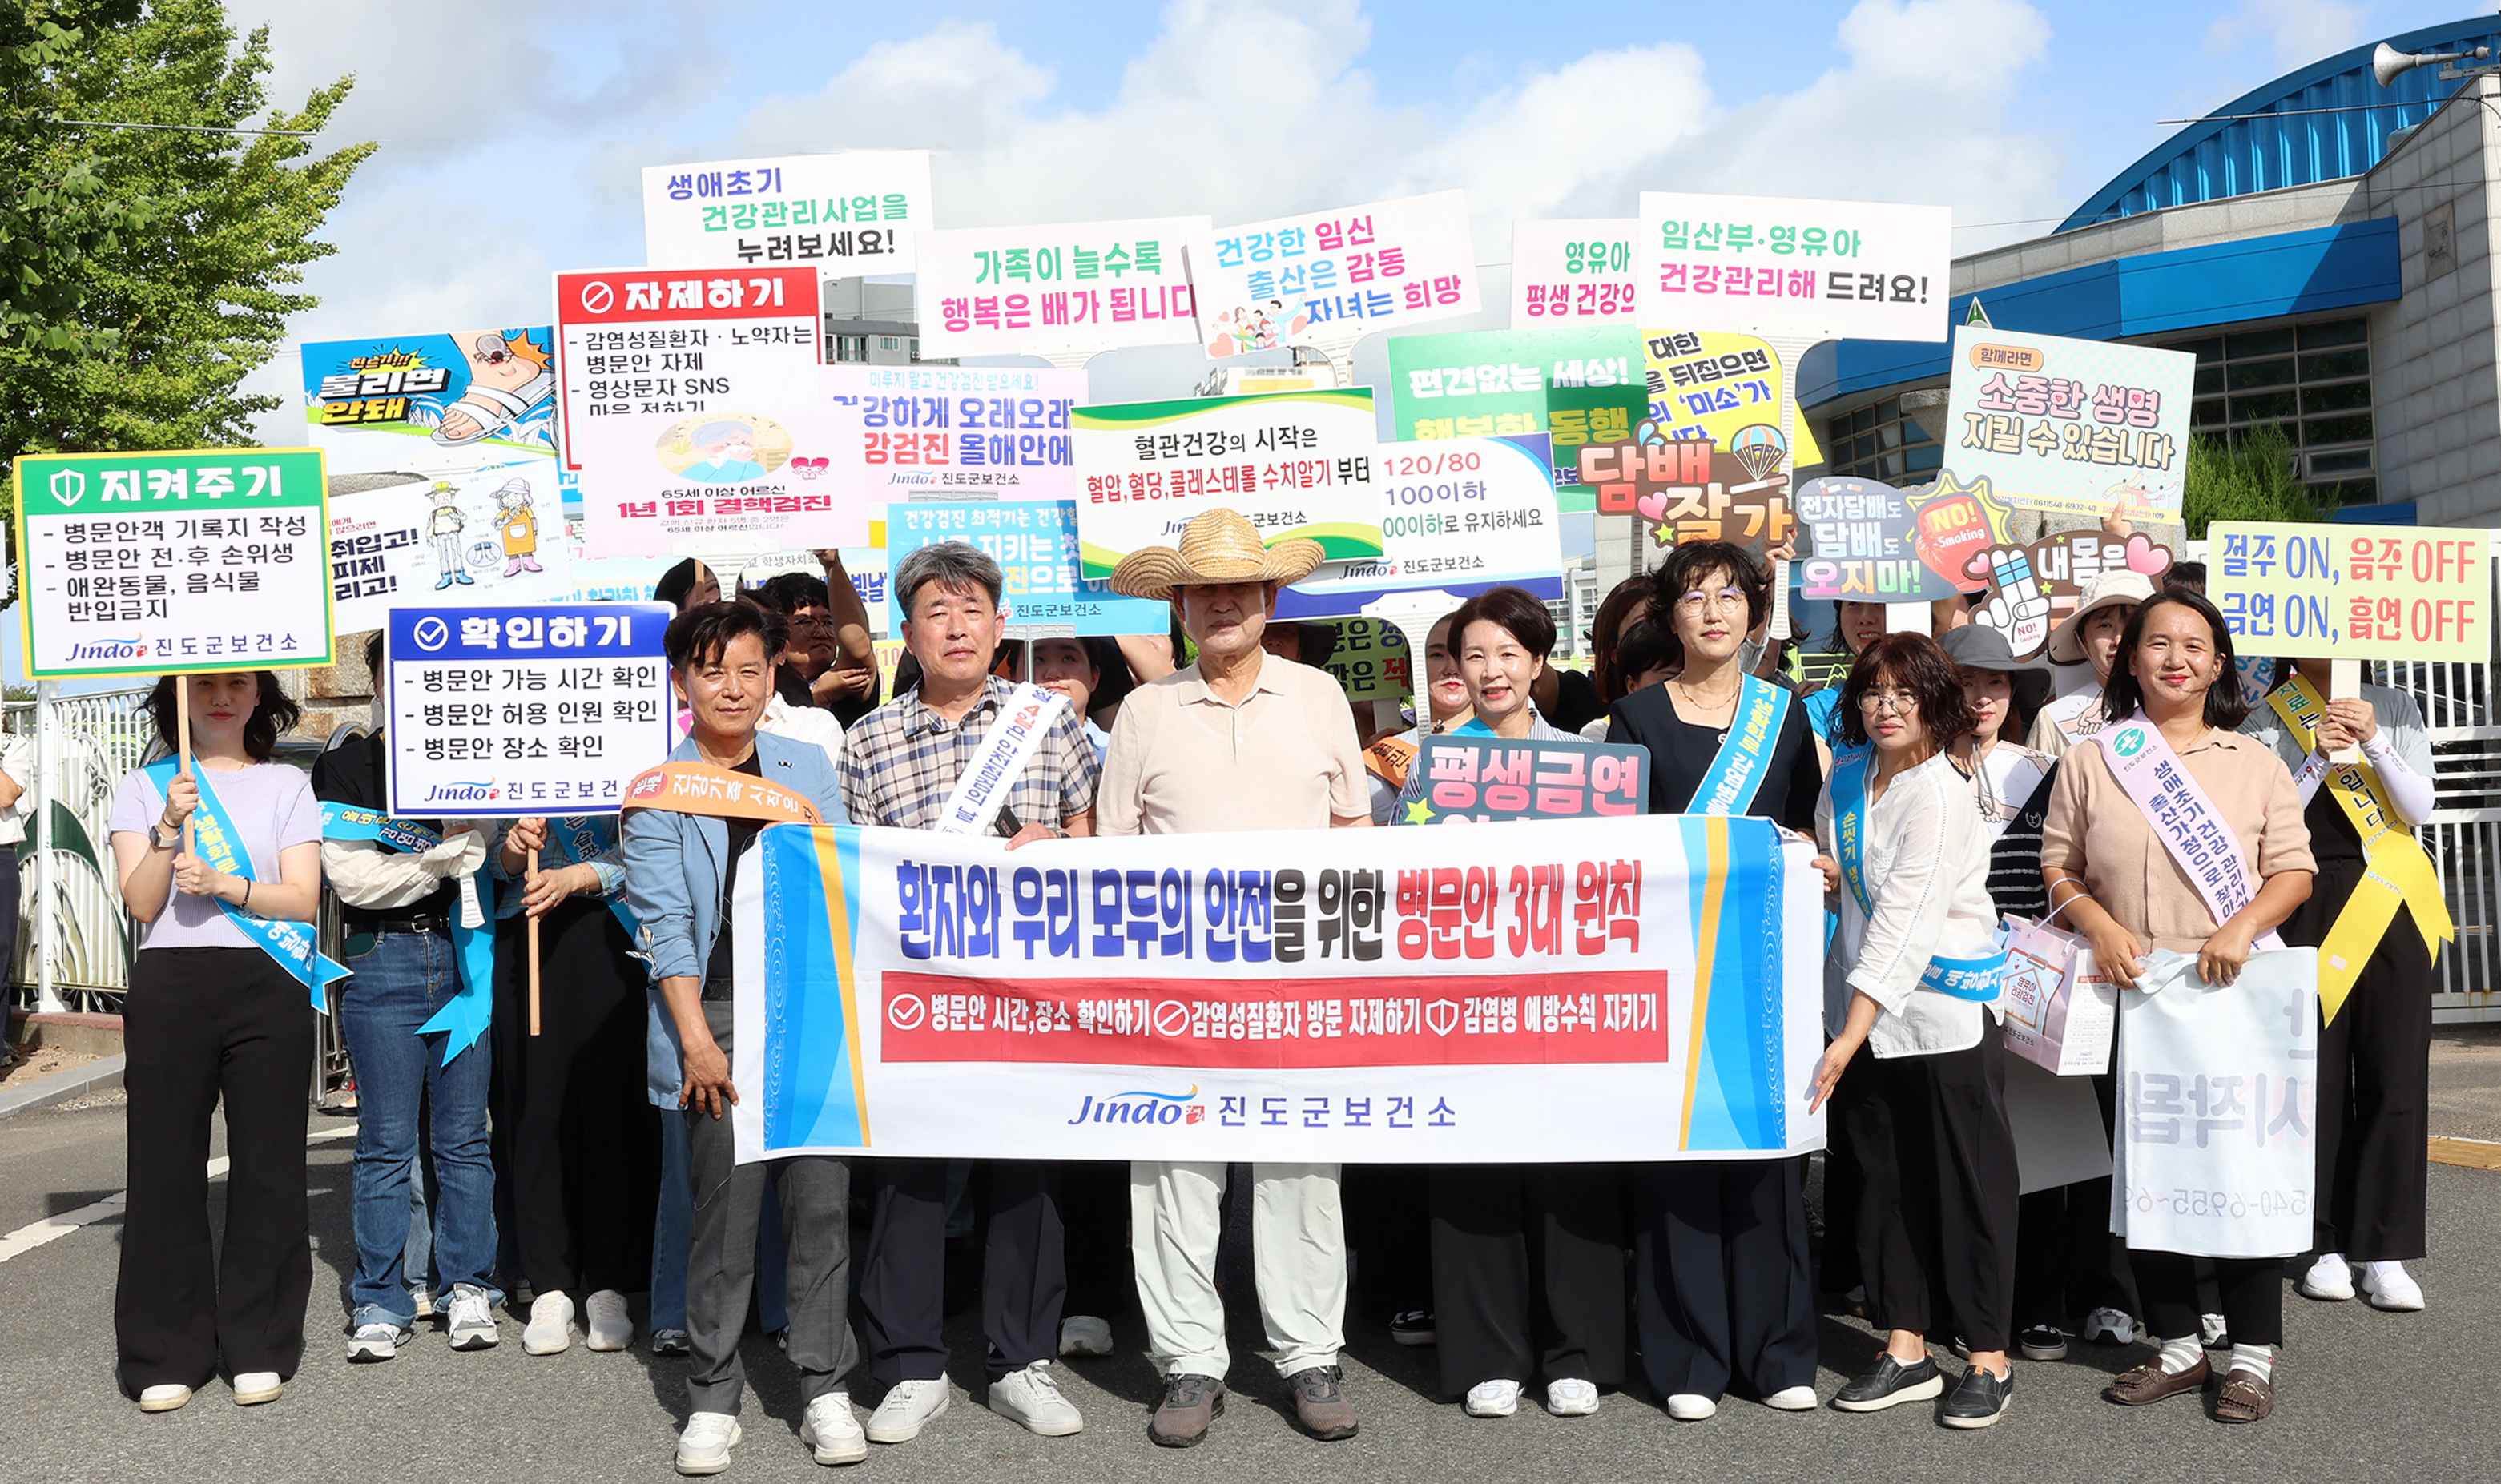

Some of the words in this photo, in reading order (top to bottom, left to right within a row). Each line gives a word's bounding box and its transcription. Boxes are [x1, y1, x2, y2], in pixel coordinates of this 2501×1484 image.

[667, 168, 782, 200] 생애초기
[703, 194, 908, 232] 건강관리사업을
[738, 229, 895, 263] 누려보세요!
[1215, 227, 1306, 268] 건강한
[1315, 215, 1375, 251] 임신
[1661, 220, 1861, 258] 임산부·영유아
[974, 246, 1062, 284] 가족이
[1073, 241, 1162, 280] 늘수록
[1247, 259, 1337, 301] 출산은
[1346, 247, 1405, 284] 감동
[1565, 241, 1631, 275] 영유아
[625, 278, 784, 311] 자제하기
[1304, 289, 1394, 324] 자녀는
[1403, 275, 1462, 310] 희망
[1660, 263, 1816, 300] 건강관리해
[1826, 271, 1928, 304] 드려요!
[941, 293, 1031, 332] 행복은
[1041, 290, 1100, 326] 배가
[1526, 284, 1569, 316] 평생
[586, 328, 708, 351] 감염성질환자
[732, 326, 812, 346] 노약자는
[1648, 332, 1702, 359] 대한
[587, 354, 652, 375] 병문안
[661, 352, 703, 371] 자제
[1669, 349, 1770, 387] 뒤집으면
[1981, 347, 2032, 367] 함께라면
[321, 368, 450, 396] 물리면
[589, 377, 677, 400] 영상문자
[685, 377, 730, 396] SNS
[869, 371, 905, 388] 미루지
[908, 372, 931, 390] 말고
[936, 372, 984, 391] 건강검진
[988, 372, 1040, 392] 받으세요!
[1409, 362, 1541, 398] 편견없는
[1553, 357, 1629, 388] 세상!
[323, 396, 409, 424] 안돼
[1979, 372, 2086, 420] 소중한
[2092, 384, 2160, 428] 생명
[1549, 407, 1629, 445] 동행
[1963, 412, 2023, 455] 지킬
[2028, 420, 2059, 456] 수
[2063, 424, 2175, 471] 있습니다
[960, 434, 1074, 465] 올해안에
[1135, 430, 1246, 460] 혈관건강의
[1255, 425, 1318, 451] 시작은
[942, 473, 1020, 485] 진도군보건소
[1263, 460, 1331, 490] 수치알기
[1338, 456, 1371, 485] 부터
[1384, 452, 1481, 476] 120/80
[1581, 443, 1713, 512] 담배
[100, 465, 282, 501] 지켜주기
[662, 486, 699, 498] 65세
[704, 485, 735, 497] 이상
[740, 485, 785, 496] 어르신
[1387, 481, 1487, 505] 100이하
[618, 501, 656, 517] 1년
[665, 499, 704, 516] 1회
[714, 494, 832, 515] 결핵검진
[904, 509, 965, 529] 건강검진
[971, 508, 1030, 529] 최적기는
[1464, 509, 1543, 533] 유지하세요
[1666, 482, 1792, 545] 잘가
[1799, 495, 1901, 521] 전자담배도
[1932, 501, 1976, 533] NO!
[64, 521, 163, 545] 병문안객
[175, 517, 249, 540] 기록지
[260, 516, 306, 537] 작성
[1814, 521, 1899, 557] 담배도
[1938, 528, 1985, 549] Smoking
[66, 549, 141, 572] 병문안
[220, 544, 293, 565] 손위생
[1403, 556, 1484, 574] 진도군보건소
[2224, 534, 2277, 577] 절주
[2286, 536, 2340, 585] ON,
[2350, 537, 2402, 581] 음주
[2411, 539, 2475, 583] OFF
[67, 575, 175, 598] 애완동물,
[186, 572, 260, 592] 음식물
[1805, 559, 1920, 595] 오지마!
[68, 598, 167, 622] 반입금지
[1017, 604, 1101, 617] 진도군보건소
[2222, 593, 2275, 636] 금연
[2285, 594, 2338, 645] ON,
[2349, 596, 2401, 641] 흡연
[2410, 598, 2475, 642] OFF
[460, 615, 631, 649] 확인하기
[2018, 622, 2037, 636] NO!
[2020, 634, 2040, 644] Smoking
[66, 637, 135, 662] Jindo
[424, 670, 493, 691] 병문안
[502, 669, 547, 690] 가능
[557, 668, 603, 689] 시간
[613, 666, 657, 688] 확인
[424, 704, 493, 726] 병문안
[502, 703, 547, 725] 허용
[558, 702, 602, 723] 인원
[613, 701, 657, 722] 확인
[425, 738, 493, 760] 병문안
[503, 737, 548, 758] 장소
[558, 736, 603, 758] 확인
[425, 783, 487, 801] Jindo
[673, 773, 744, 802] 건강가족
[750, 785, 799, 813] 시작은
[1430, 746, 1639, 816] 평생금연
[955, 806, 978, 824] 날
[2153, 760, 2205, 822] 생애초기
[2197, 820, 2229, 855] 건강
[1842, 811, 1856, 860] 손씻기
[2149, 794, 2223, 887] 출산가정으로
[896, 859, 1002, 959] 환자와
[1014, 867, 1080, 960] 우리
[1092, 867, 1194, 960] 모두의
[1206, 867, 1307, 963] 안전을
[1317, 868, 1386, 962] 위한
[1397, 865, 1499, 961] 병문안
[1508, 863, 1565, 958] 3대
[1575, 859, 1642, 957] 원칙
[930, 993, 986, 1032] 병문안
[992, 996, 1071, 1036] 시간,장소
[1077, 999, 1150, 1037] 확인하기
[1192, 1000, 1301, 1040] 감염성질환자
[1307, 999, 1343, 1038] 방문
[1349, 997, 1421, 1036] 자제하기
[1464, 996, 1518, 1035] 감염병
[1524, 993, 1597, 1033] 예방수칙
[1603, 992, 1657, 1032] 지키기
[1068, 1095, 1183, 1126] Jindo
